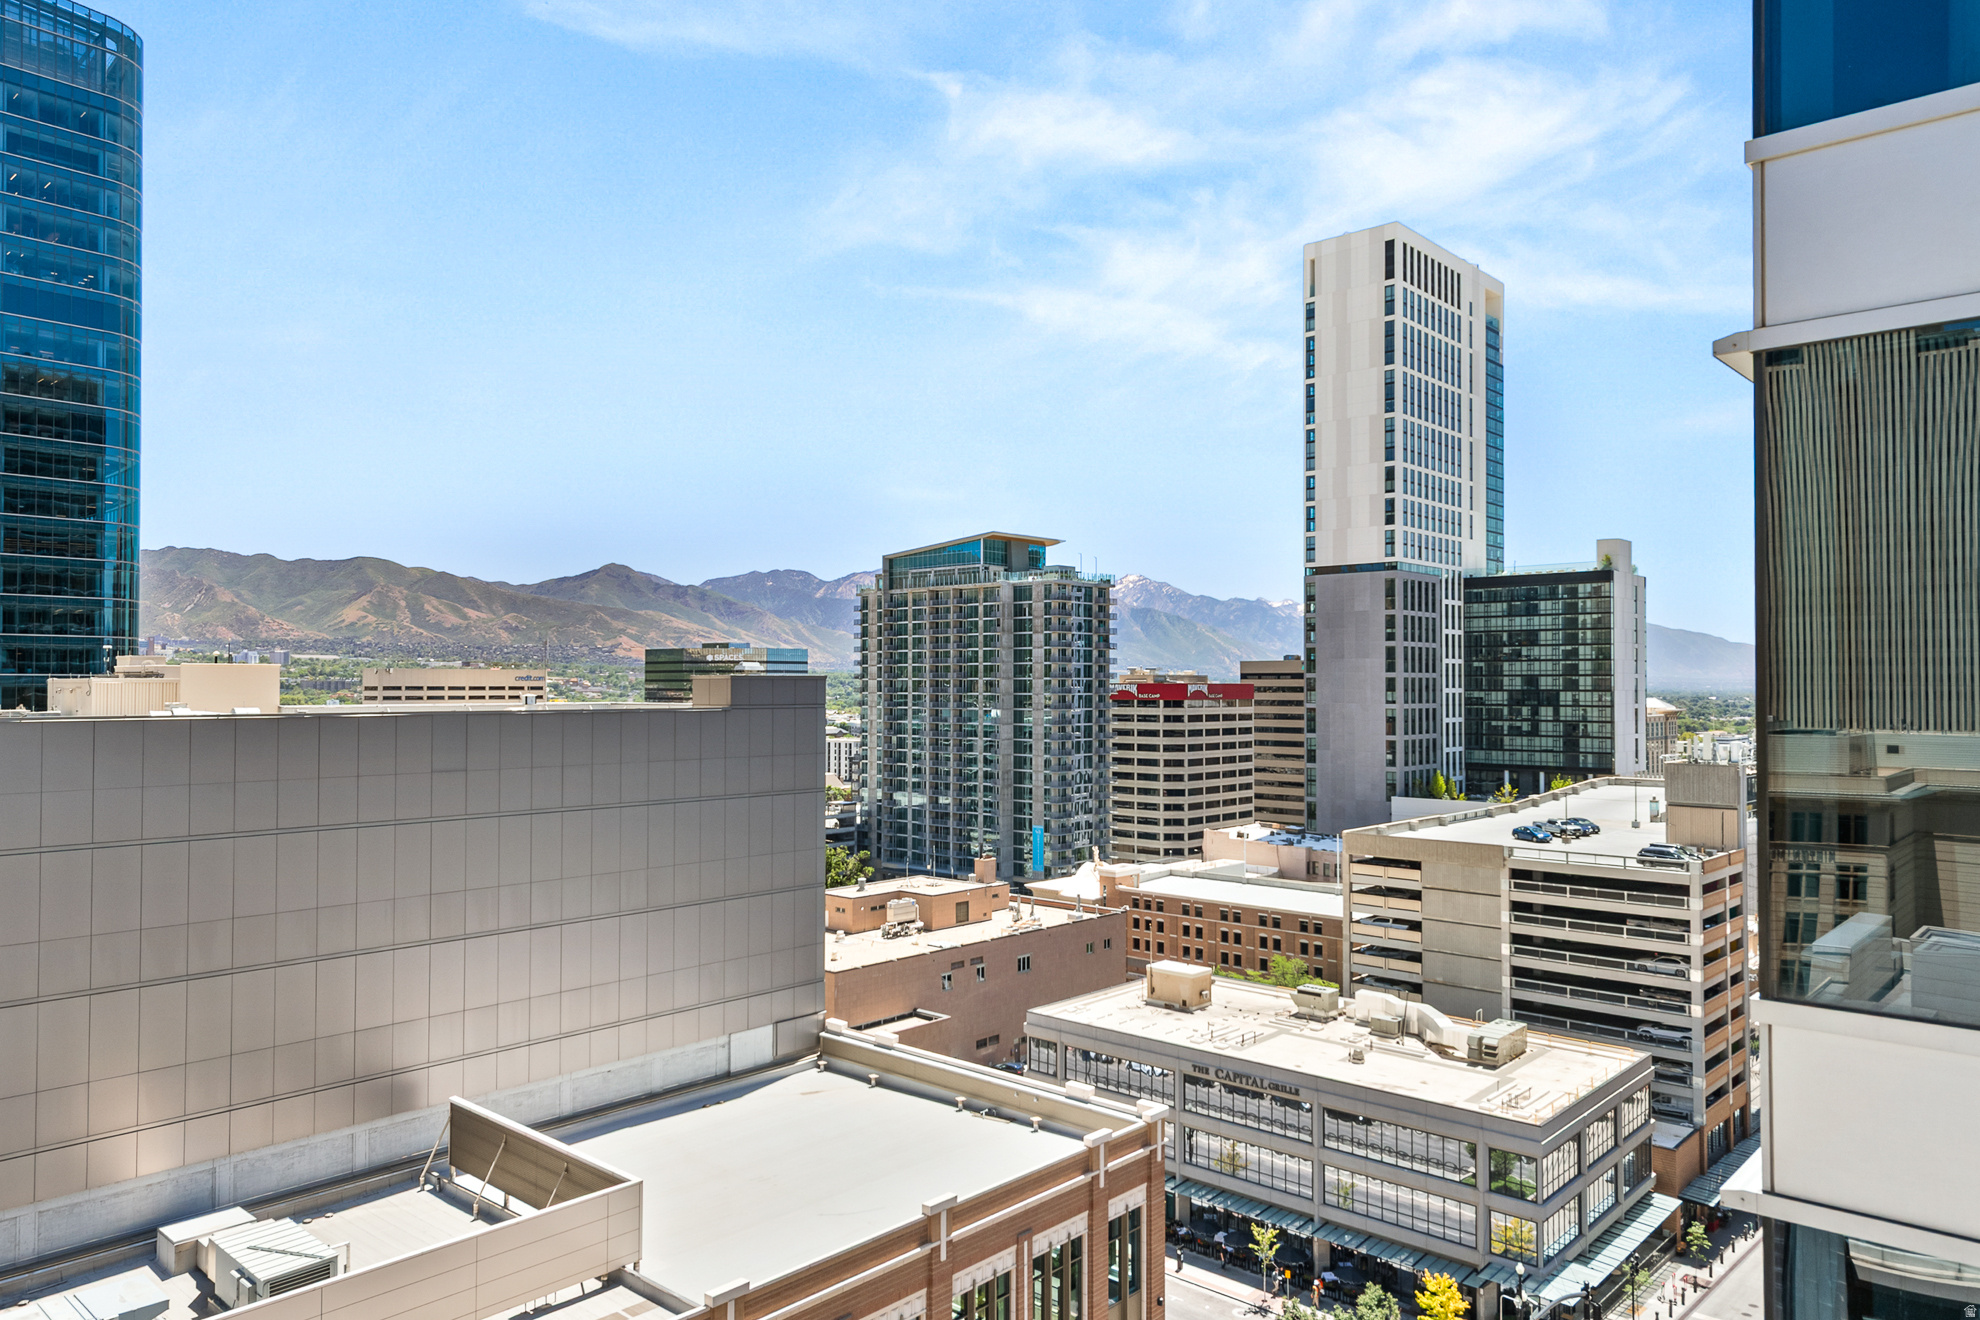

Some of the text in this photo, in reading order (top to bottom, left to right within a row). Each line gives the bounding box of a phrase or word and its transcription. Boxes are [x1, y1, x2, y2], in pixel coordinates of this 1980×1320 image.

[714, 653, 744, 661] SPACES
[1192, 1064, 1300, 1096] THE CAPITAL GRILLE
